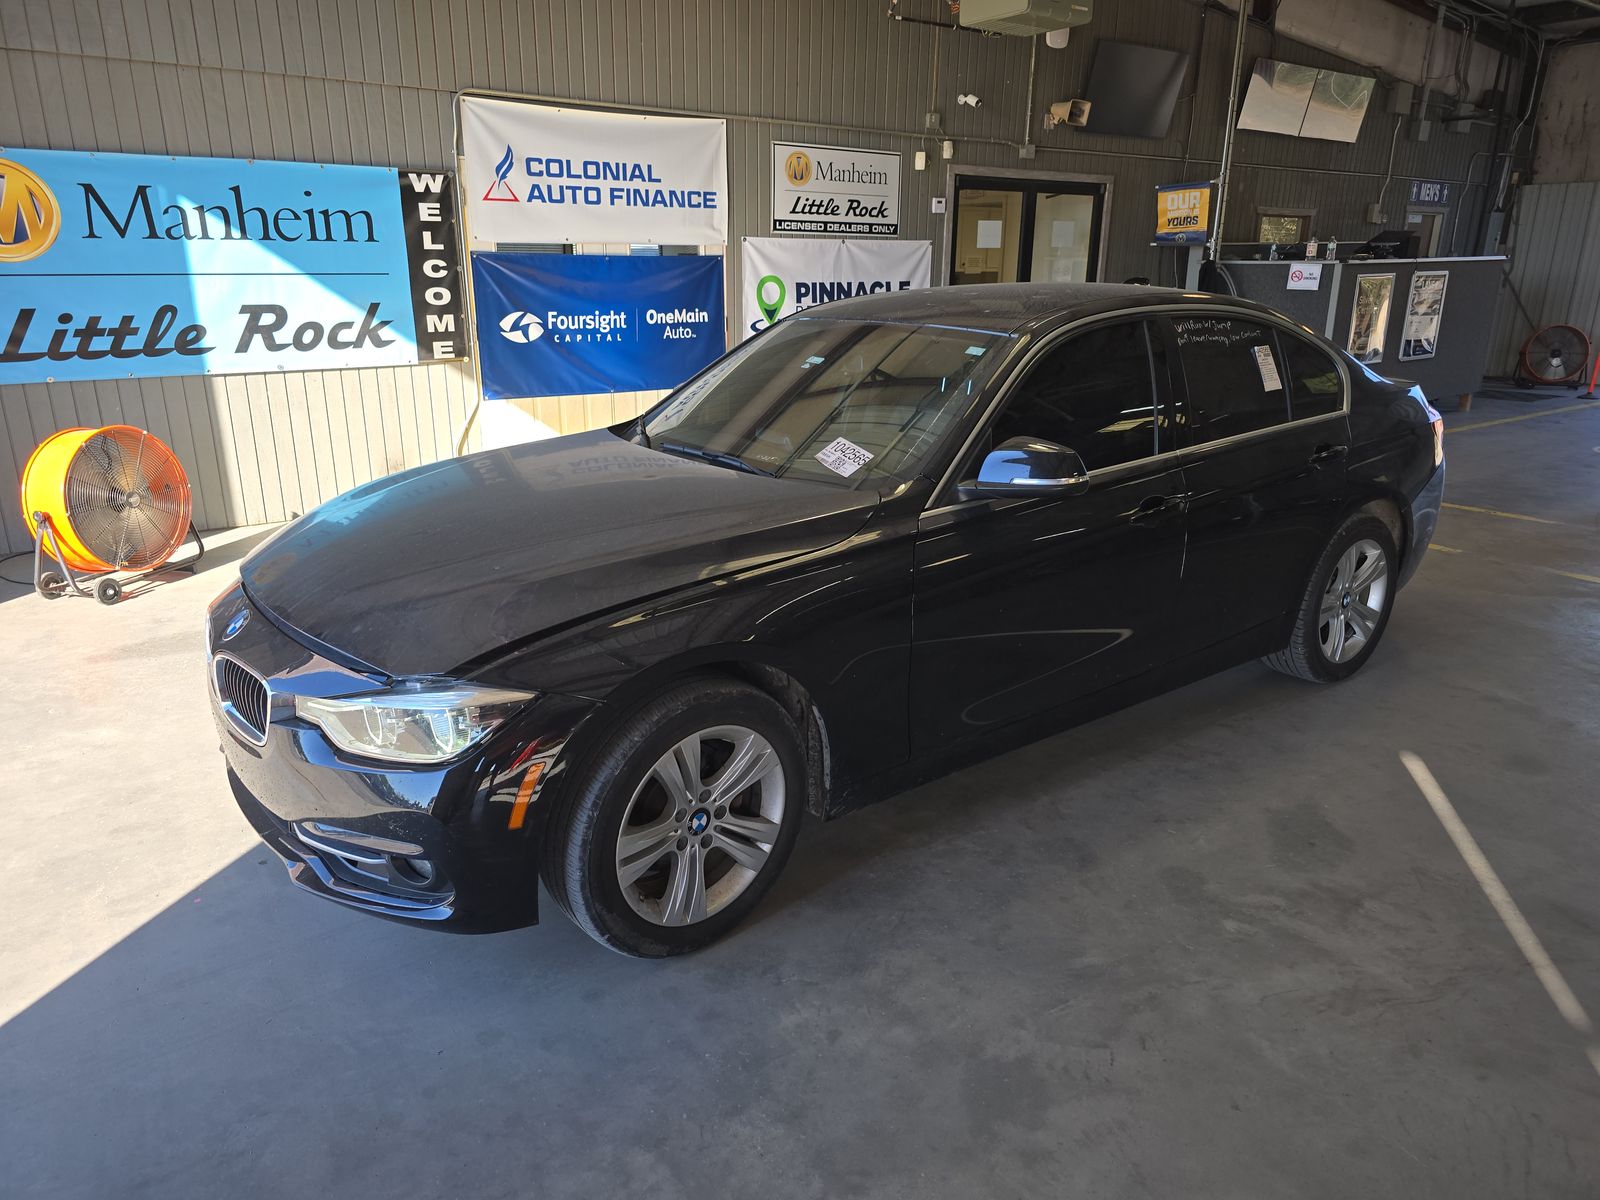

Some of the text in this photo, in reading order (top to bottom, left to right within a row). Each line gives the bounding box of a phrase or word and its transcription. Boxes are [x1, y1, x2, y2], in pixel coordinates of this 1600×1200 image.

[525, 156, 662, 183] COLONIAL
[815, 160, 889, 185] Manheim
[526, 183, 718, 209] AUTO FINANCE
[1167, 191, 1201, 209] OUR
[1419, 182, 1441, 202] MEN'S
[76, 182, 379, 243] Manheim
[789, 196, 890, 219] Little Rock
[776, 221, 896, 234] LICENSED DEALERS ONLY
[1167, 215, 1199, 227] YOURS
[407, 172, 456, 360] WELCOME
[547, 310, 627, 333] Foursight
[645, 308, 709, 325] OneMain
[0, 302, 396, 363] Little Rock
[554, 333, 623, 342] CAPITAL
[831, 440, 870, 466] 1042565
